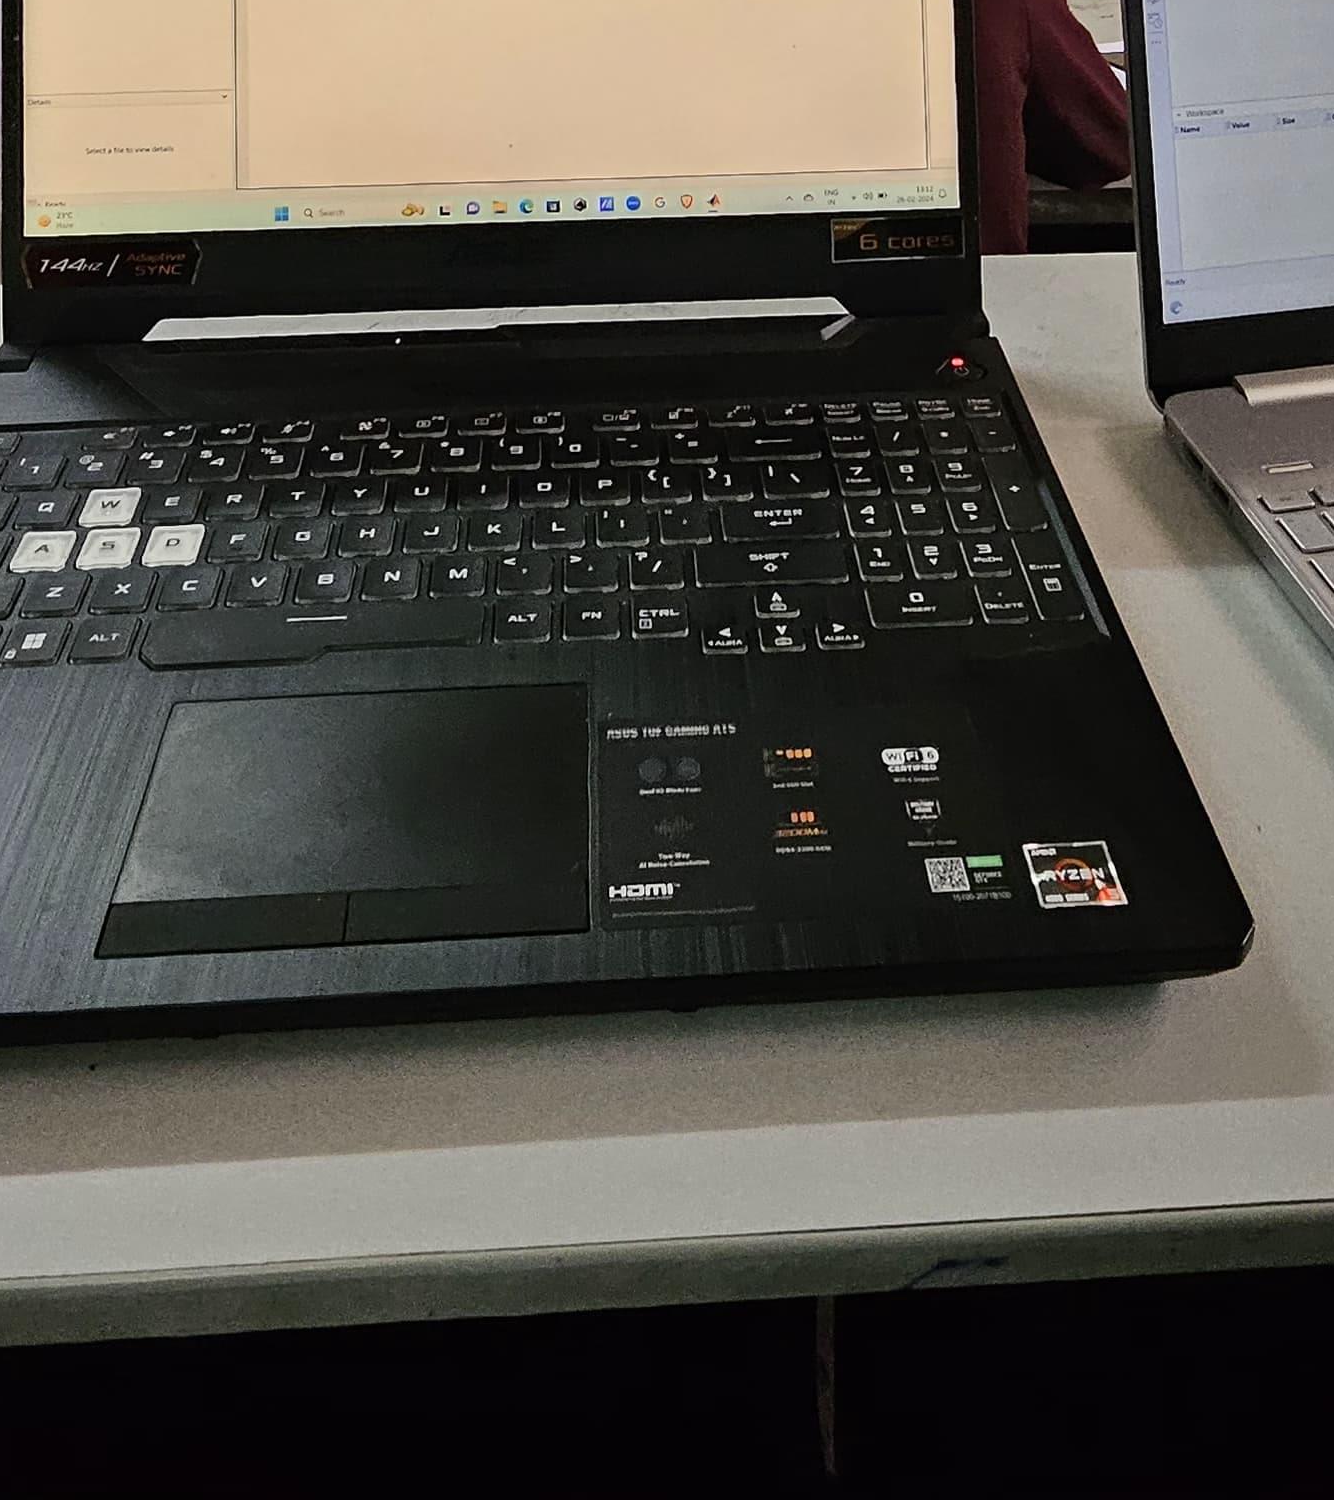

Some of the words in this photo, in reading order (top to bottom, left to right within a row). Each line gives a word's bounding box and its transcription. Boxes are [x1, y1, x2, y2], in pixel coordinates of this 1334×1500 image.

[1180, 126, 1201, 134] Name
[1232, 122, 1251, 130] Value
[1282, 117, 1296, 125] Size
[859, 233, 879, 251] 6
[887, 234, 955, 251] cores
[125, 252, 187, 263] Adaptive
[135, 263, 184, 276] SYNC
[390, 449, 404, 459] 7
[848, 466, 863, 476] 7
[598, 479, 613, 489] P
[291, 490, 306, 500] T
[354, 488, 368, 498] Y
[414, 486, 430, 496] U
[101, 499, 121, 509] W
[164, 496, 181, 507] E
[226, 493, 243, 504] R
[37, 502, 55, 514] Q
[859, 505, 876, 516] 4
[910, 503, 926, 514] 5
[962, 502, 979, 512] 6
[753, 508, 803, 518] ENTER
[423, 525, 440, 536] J
[487, 523, 502, 534] K
[551, 521, 566, 532] L
[229, 533, 247, 545] F
[359, 528, 376, 539] H
[101, 540, 116, 550] S
[165, 537, 181, 547] D
[34, 543, 50, 554] A
[748, 552, 791, 561] SHIFT
[317, 573, 334, 585] B
[384, 570, 401, 582] N
[449, 568, 469, 579] M
[182, 580, 199, 591] C
[250, 576, 268, 588] V
[46, 586, 65, 598] Z
[114, 583, 132, 595] X
[507, 613, 538, 623] ALT
[581, 610, 603, 621] FN
[638, 608, 681, 618] CTRL
[89, 633, 120, 643] ALT
[664, 723, 711, 738] GAMING
[887, 763, 938, 773] CERTIFIED
[1045, 867, 1106, 882] RYZEN
[608, 882, 675, 899] HDMI
